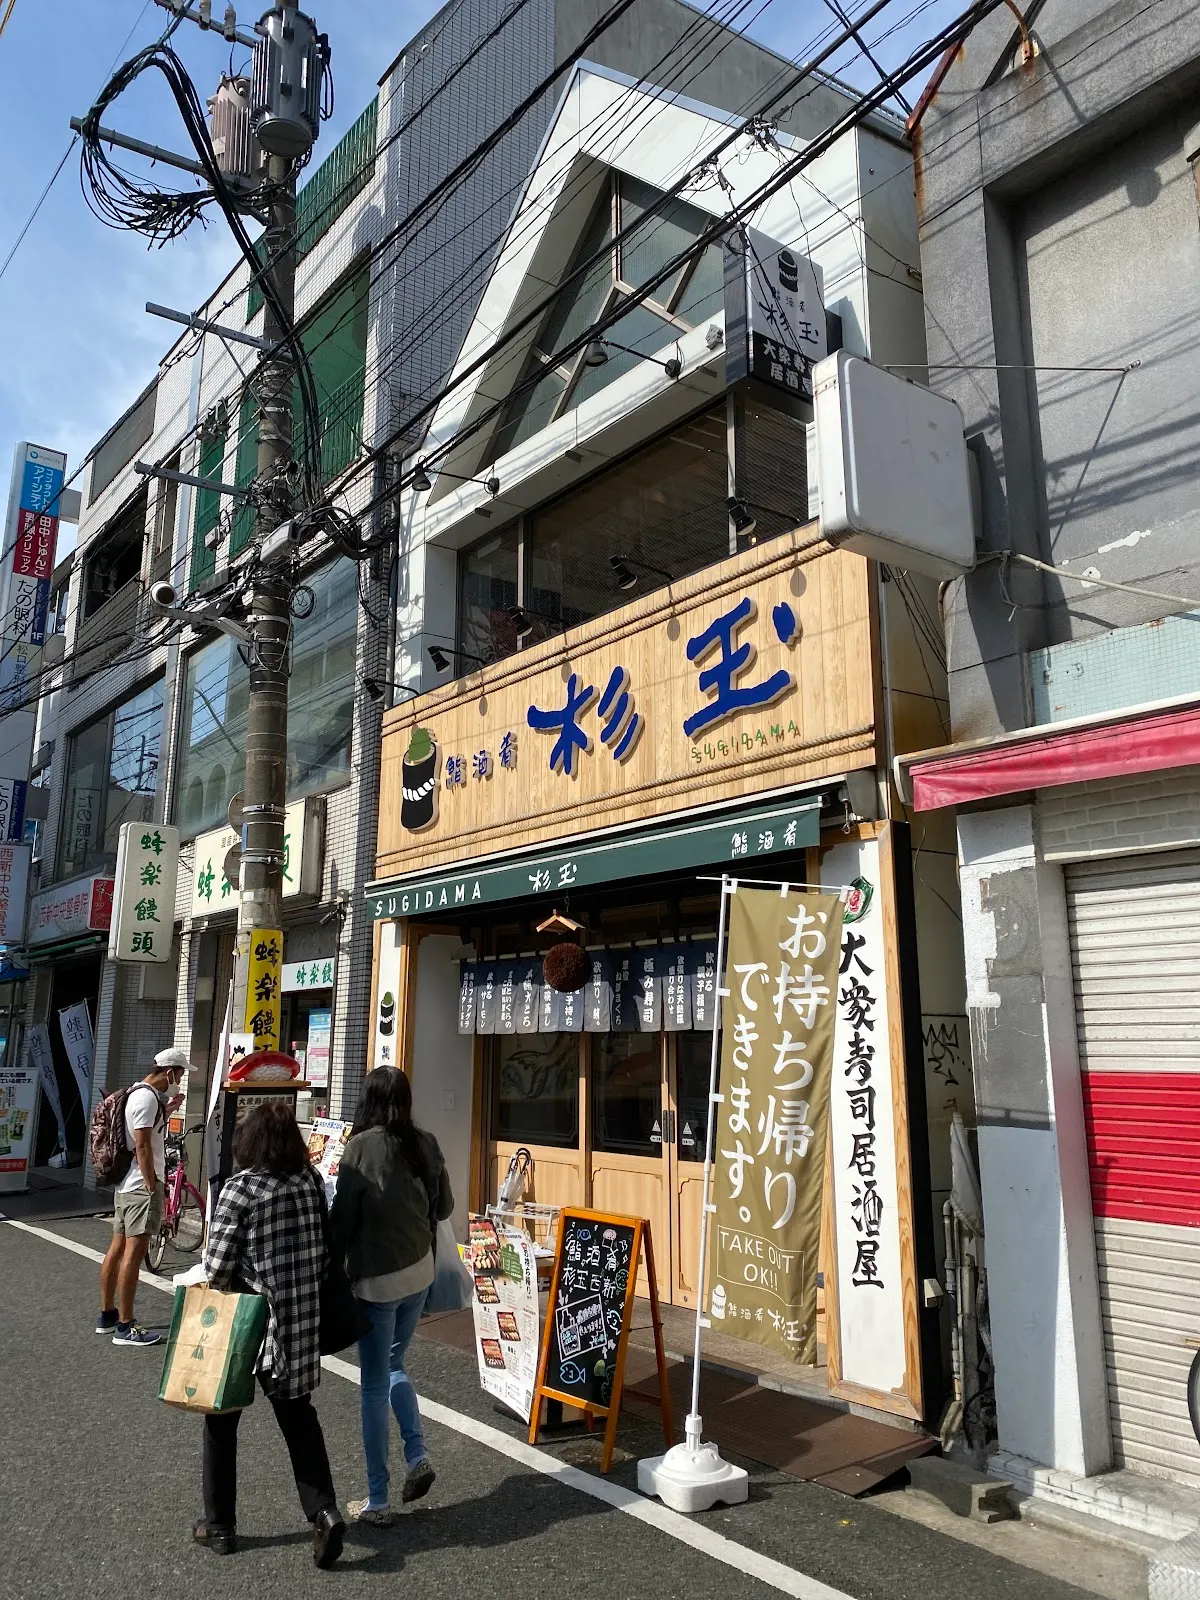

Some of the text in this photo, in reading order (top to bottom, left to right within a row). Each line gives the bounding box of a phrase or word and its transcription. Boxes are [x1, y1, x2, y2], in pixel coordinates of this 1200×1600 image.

[759, 301, 819, 345] 杉玉
[30, 465, 45, 510] アイシティ
[34, 515, 52, 577] 田中じゅんこ
[13, 579, 34, 637] たの眼科
[31, 632, 43, 641] 1F
[527, 597, 798, 775] 杉玉
[445, 731, 517, 787] 鮨酒肴
[691, 719, 799, 762] SUGIDAMA
[731, 819, 798, 857] 鮨酒肴
[131, 831, 167, 959] 蜂楽饅頭
[374, 880, 482, 917] SUGIDAMA
[528, 863, 579, 892] 杉玉
[757, 903, 831, 1230] お持ち帰り
[720, 961, 770, 1224] できます。
[565, 1240, 618, 1271] 鮨酒肴
[720, 1230, 795, 1274] TAKE OUT
[744, 1263, 778, 1292] OK!!
[728, 1302, 764, 1323] 鮨酒肴
[767, 1308, 808, 1342] 杉玉
